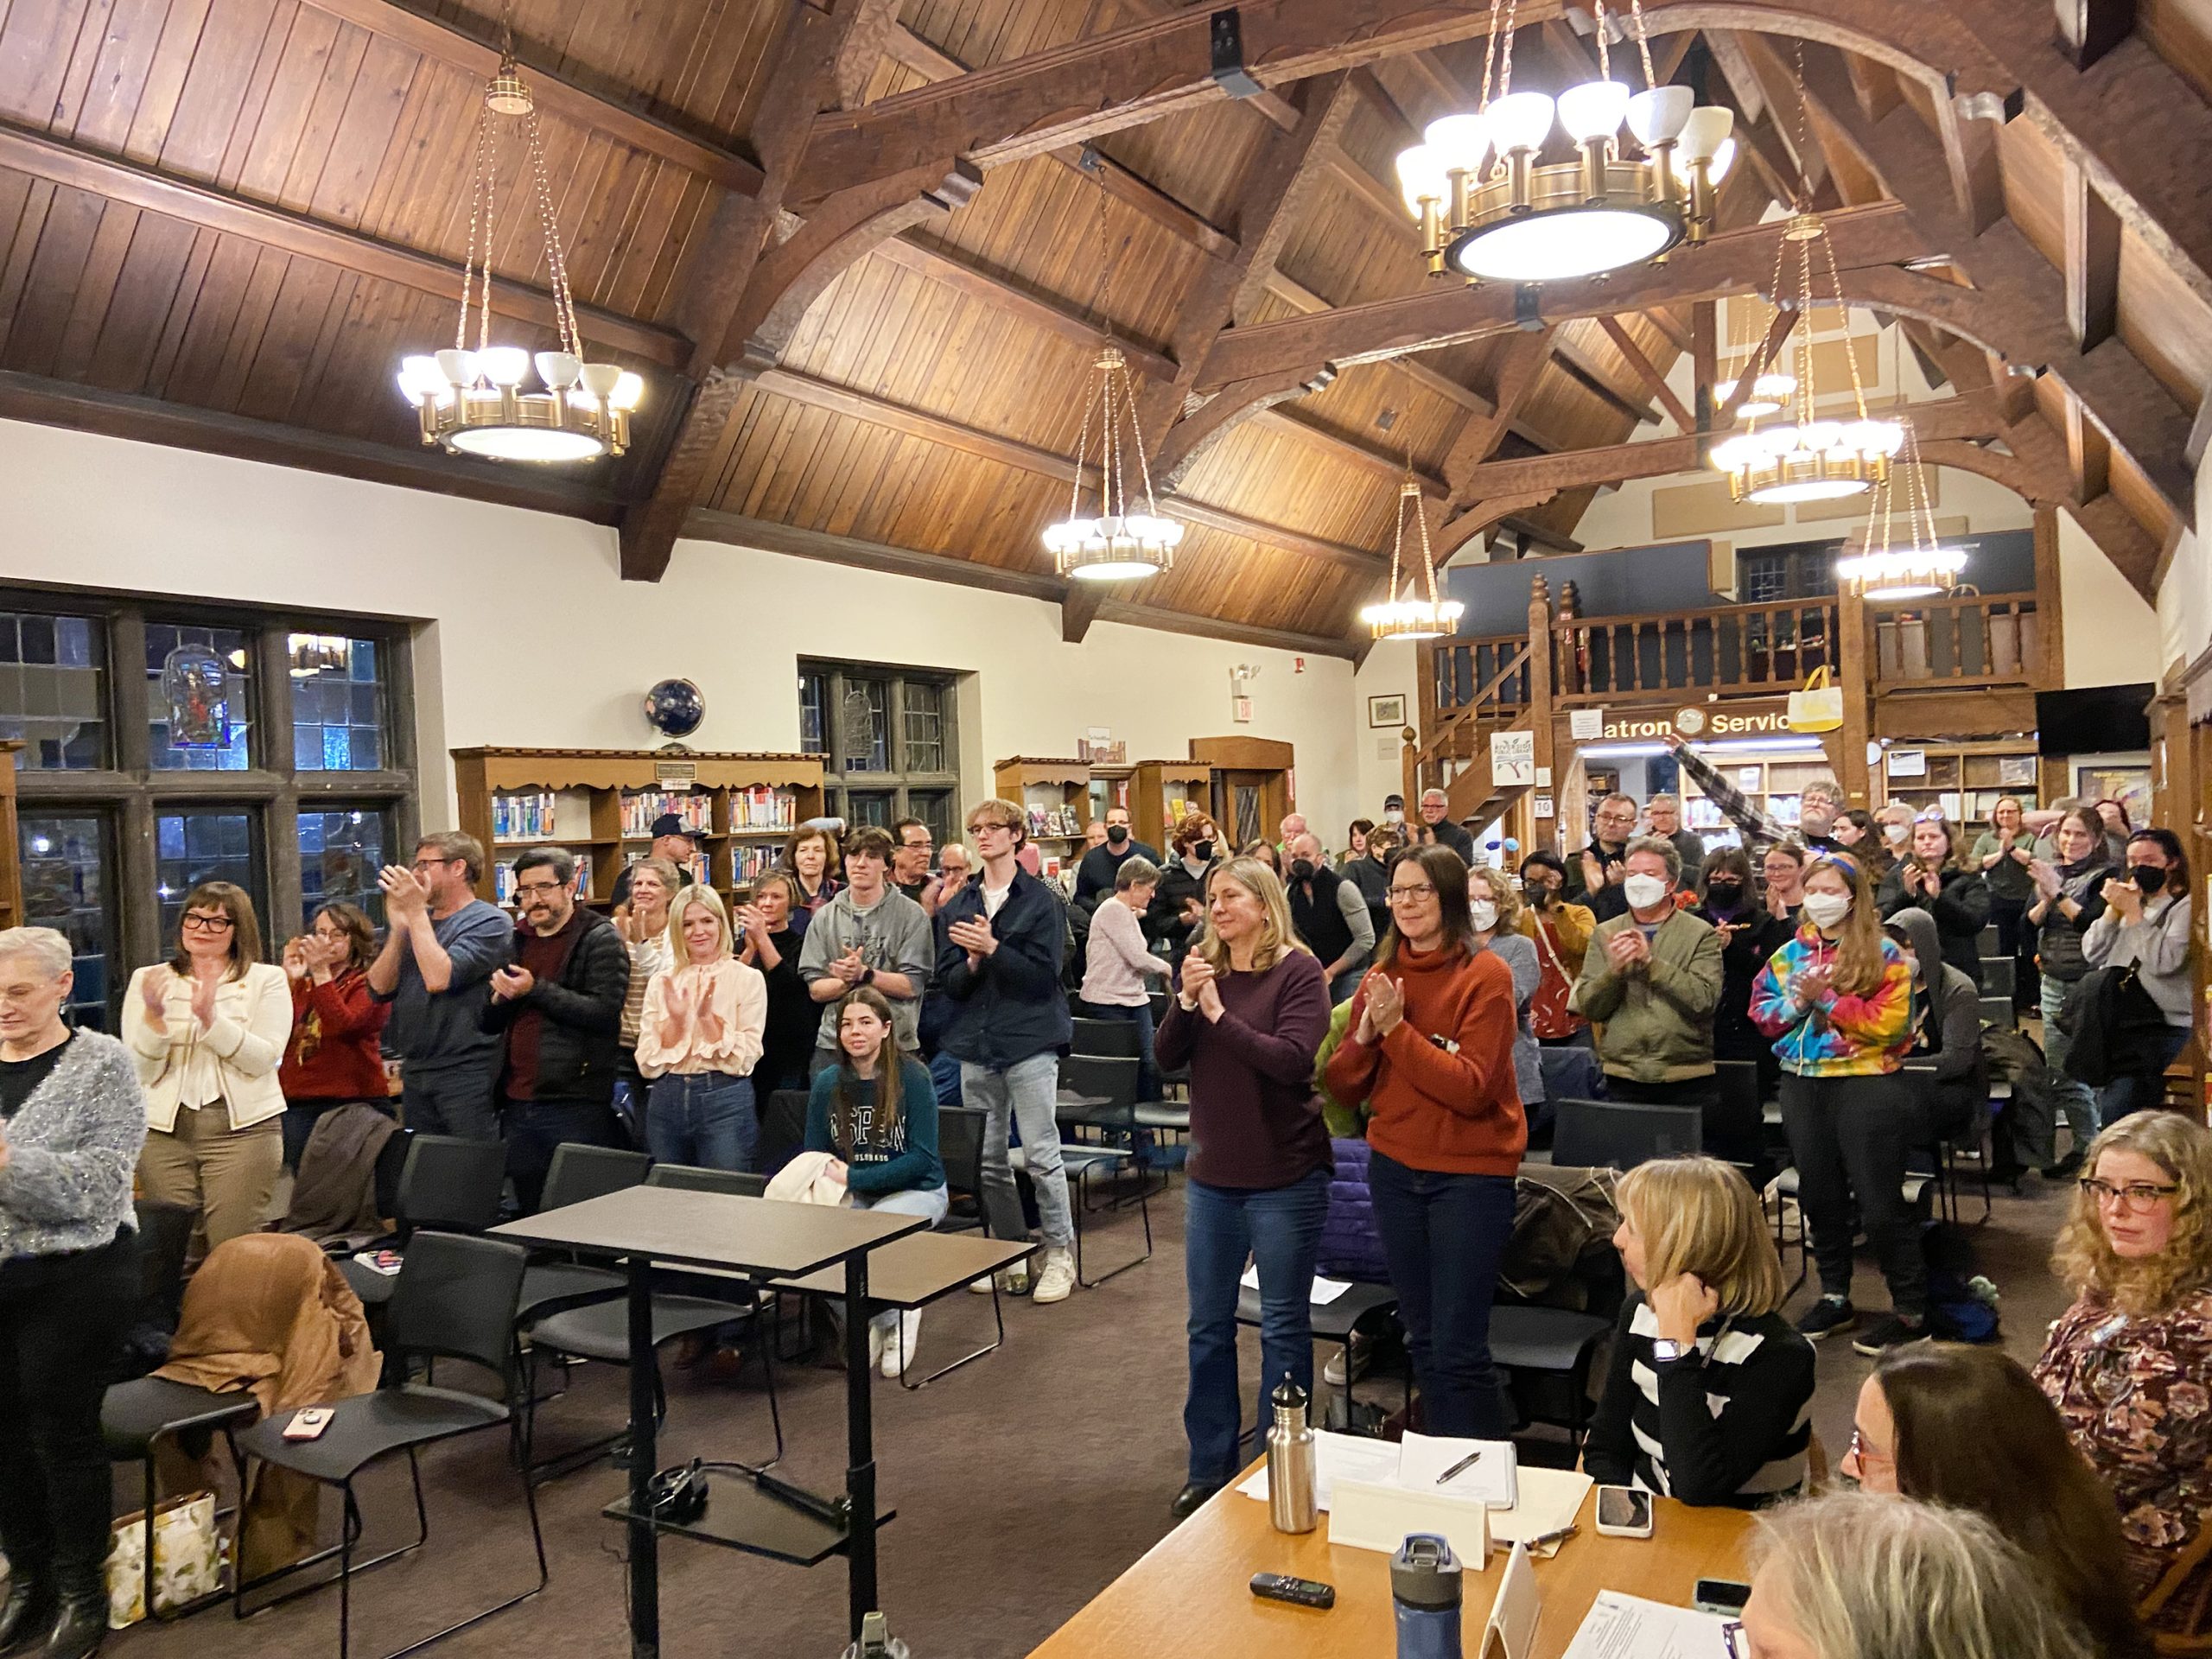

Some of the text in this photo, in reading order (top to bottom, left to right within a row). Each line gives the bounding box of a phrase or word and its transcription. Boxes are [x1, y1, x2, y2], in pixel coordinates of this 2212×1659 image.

[1604, 720, 1671, 739] atron
[1711, 712, 1789, 734] Servic
[1537, 802, 1549, 811] 10
[854, 1154, 889, 1162] OLORADO
